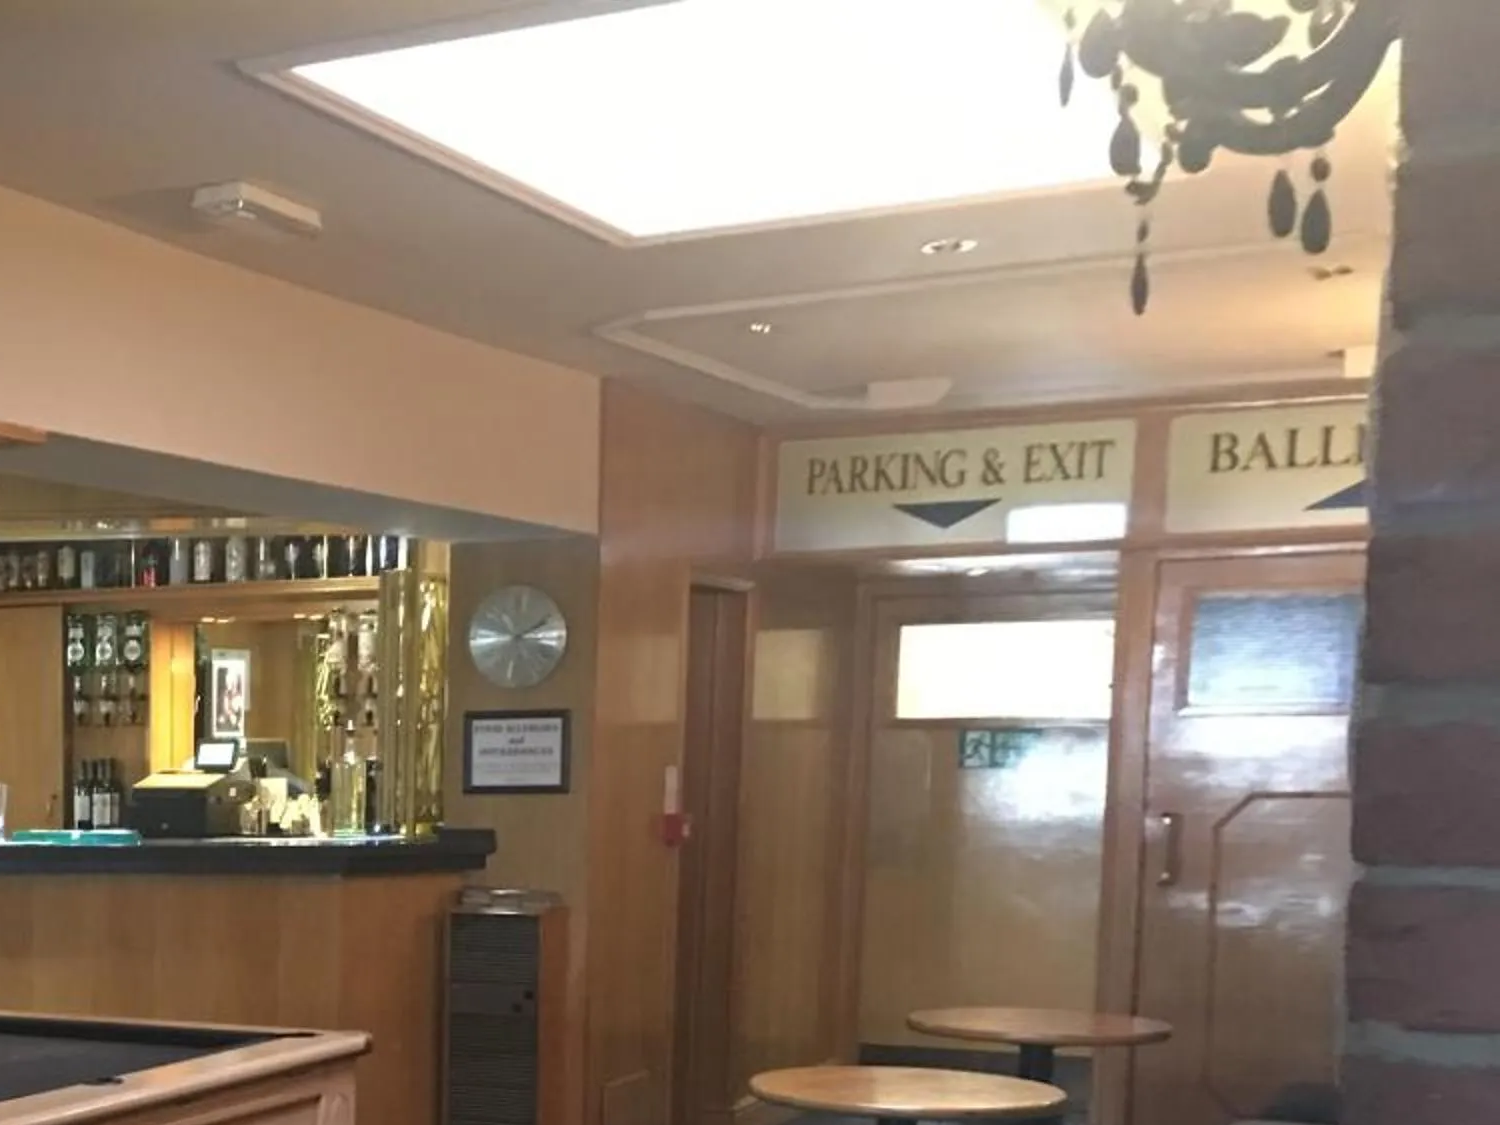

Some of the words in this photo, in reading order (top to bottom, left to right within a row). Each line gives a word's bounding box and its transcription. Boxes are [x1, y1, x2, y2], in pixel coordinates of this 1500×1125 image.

[806, 448, 966, 496] PARKING
[981, 447, 1005, 486] &
[1022, 439, 1116, 484] EXIT
